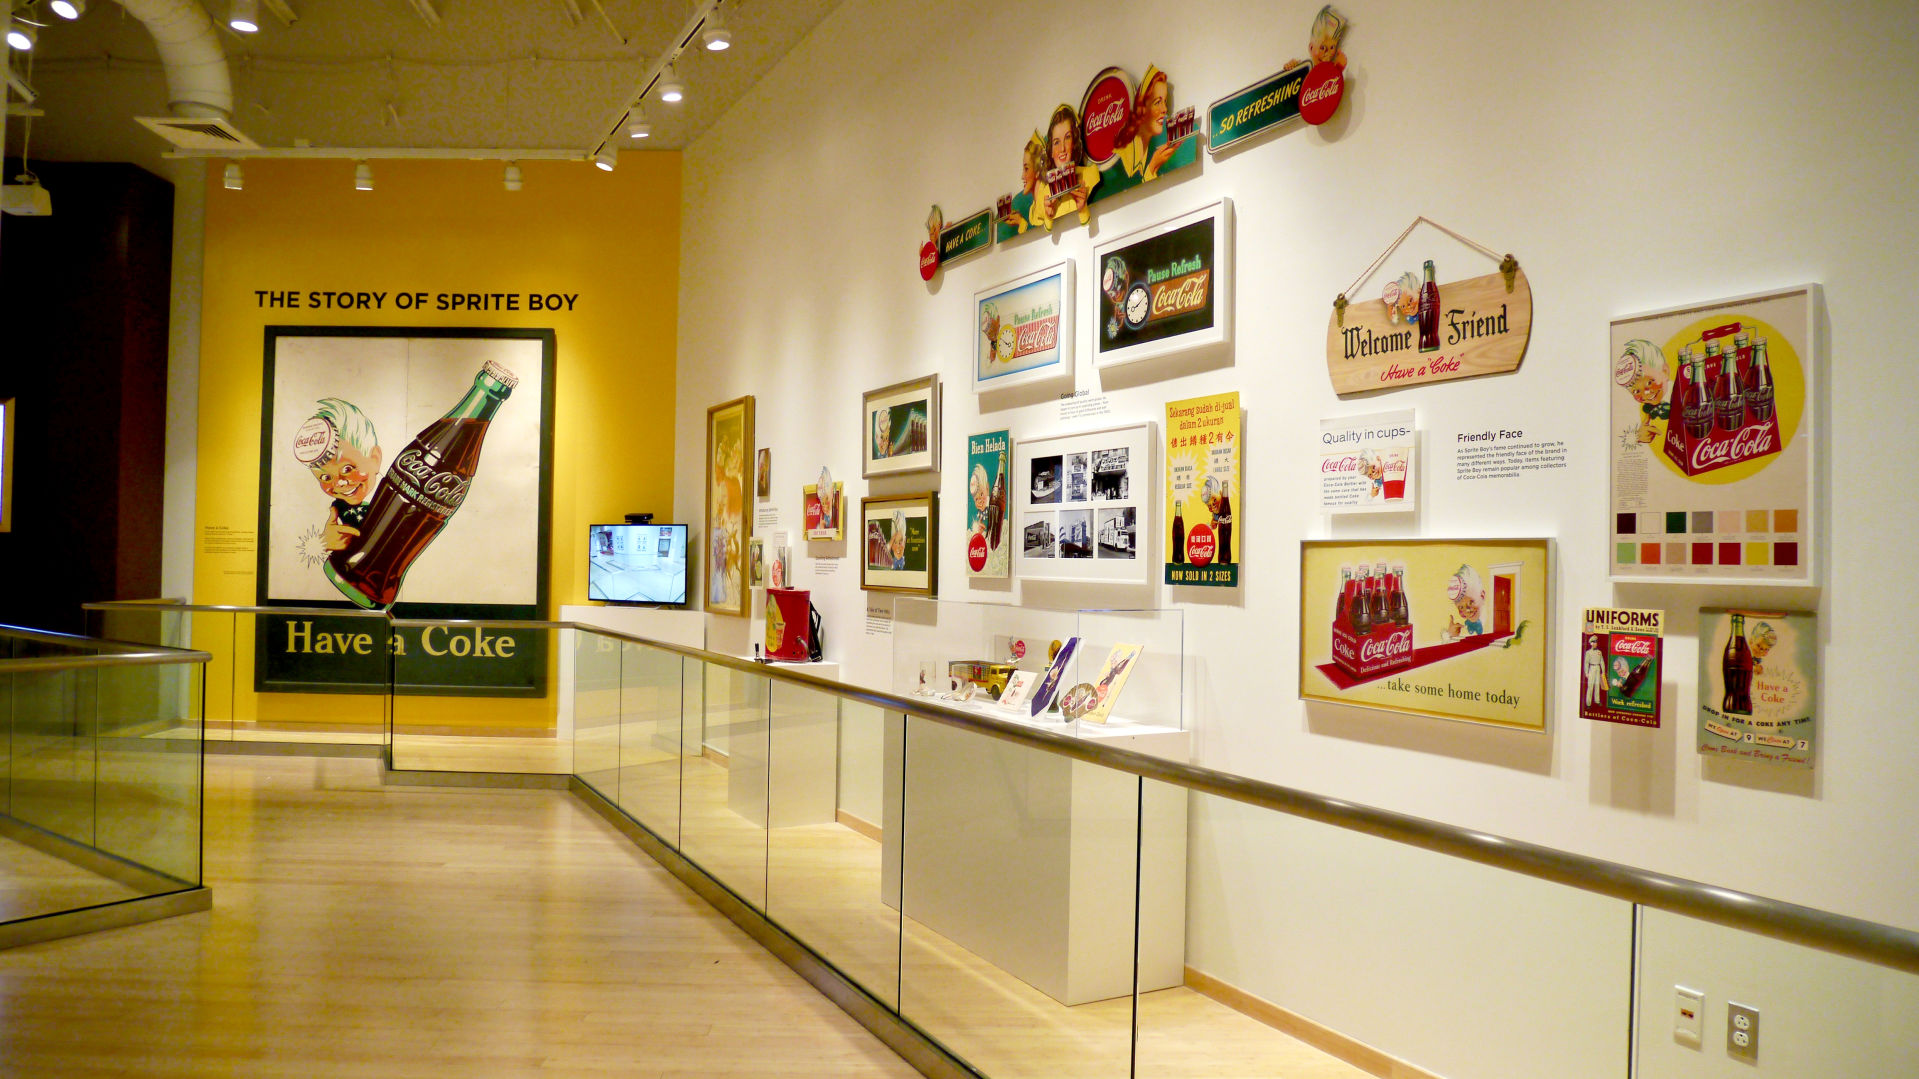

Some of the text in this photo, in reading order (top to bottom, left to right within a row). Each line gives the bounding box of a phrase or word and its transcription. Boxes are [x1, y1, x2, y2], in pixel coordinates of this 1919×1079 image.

[1098, 94, 1112, 104] DRINK
[1302, 76, 1339, 107] Coca-Cola
[1236, 77, 1301, 127] REFRESHING
[1087, 98, 1125, 136] Coca-Cola
[946, 235, 959, 252] HAVE
[960, 233, 964, 244] A
[1148, 254, 1201, 284] Pause Refresh
[255, 291, 579, 311] THE STORY OF SPRITE BOY
[1152, 274, 1207, 314] Coca-Cola
[1032, 304, 1052, 320] Refresh
[1018, 321, 1055, 352] Coca-Cola
[1341, 303, 1510, 360] Welcome Friend
[1381, 363, 1415, 382] Have
[1417, 365, 1426, 376] a
[1197, 418, 1202, 428] 2
[295, 431, 326, 448] Coca-Cola
[1322, 430, 1362, 445] Quality
[1365, 429, 1374, 439] in
[1457, 429, 1523, 443] Friendly Face
[1667, 429, 1685, 452] Coke
[1692, 421, 1775, 469] Coca-Cola
[971, 437, 1006, 455] Bien Helada
[1321, 456, 1357, 473] Coca-Cola
[395, 449, 471, 507] Coca-Cola
[400, 481, 419, 500] MARK
[1189, 545, 1213, 558] Coca-Cola
[1172, 570, 1231, 581] NOW SOLD IN 2 SIZES
[1586, 610, 1659, 627] UNIFORMS
[286, 621, 516, 657] Have a Coke
[1361, 630, 1411, 662] Coca-Cola
[1615, 640, 1651, 654] Coca-Cola
[1334, 638, 1355, 660] Coke
[1757, 680, 1780, 692] Have
[1415, 684, 1443, 696] some
[1448, 683, 1481, 701] home
[1486, 689, 1520, 709] today
[1611, 698, 1652, 709] Work refreshed
[1761, 693, 1785, 703] Coke
[1703, 705, 1720, 716] DROP
